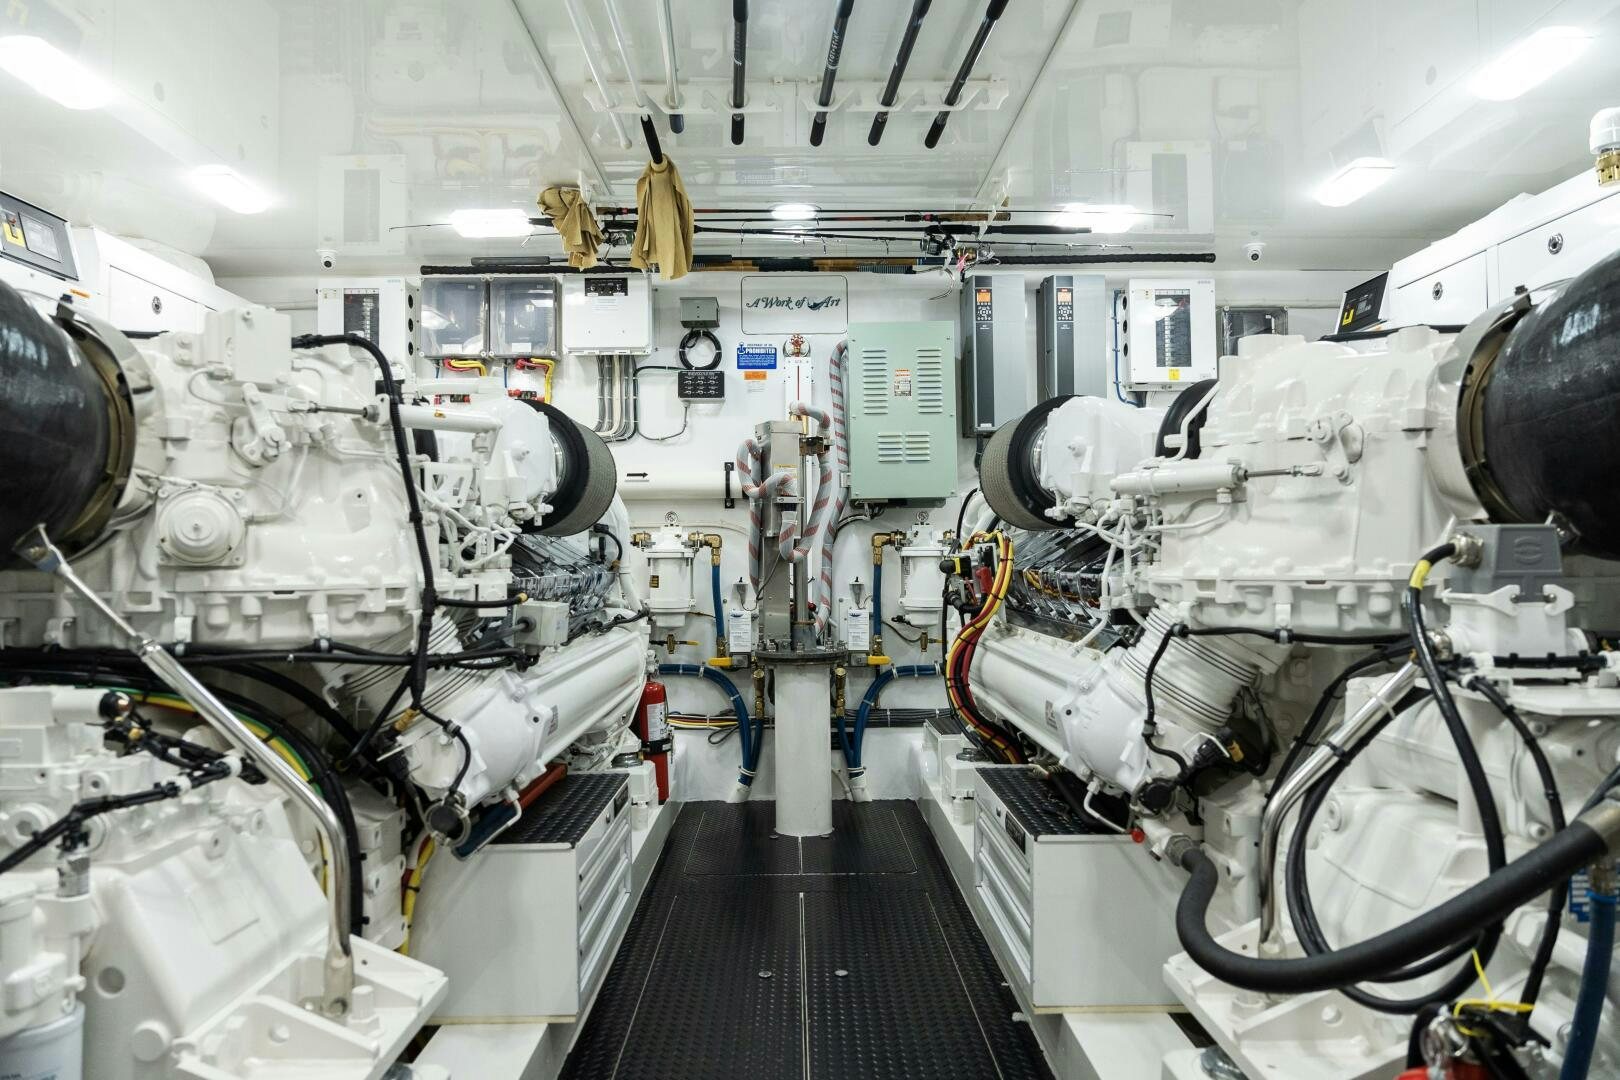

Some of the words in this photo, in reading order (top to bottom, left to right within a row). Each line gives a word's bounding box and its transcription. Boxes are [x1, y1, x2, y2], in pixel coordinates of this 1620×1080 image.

[746, 298, 760, 308] A
[761, 296, 793, 310] Work
[795, 296, 807, 308] of
[820, 296, 841, 308] Art
